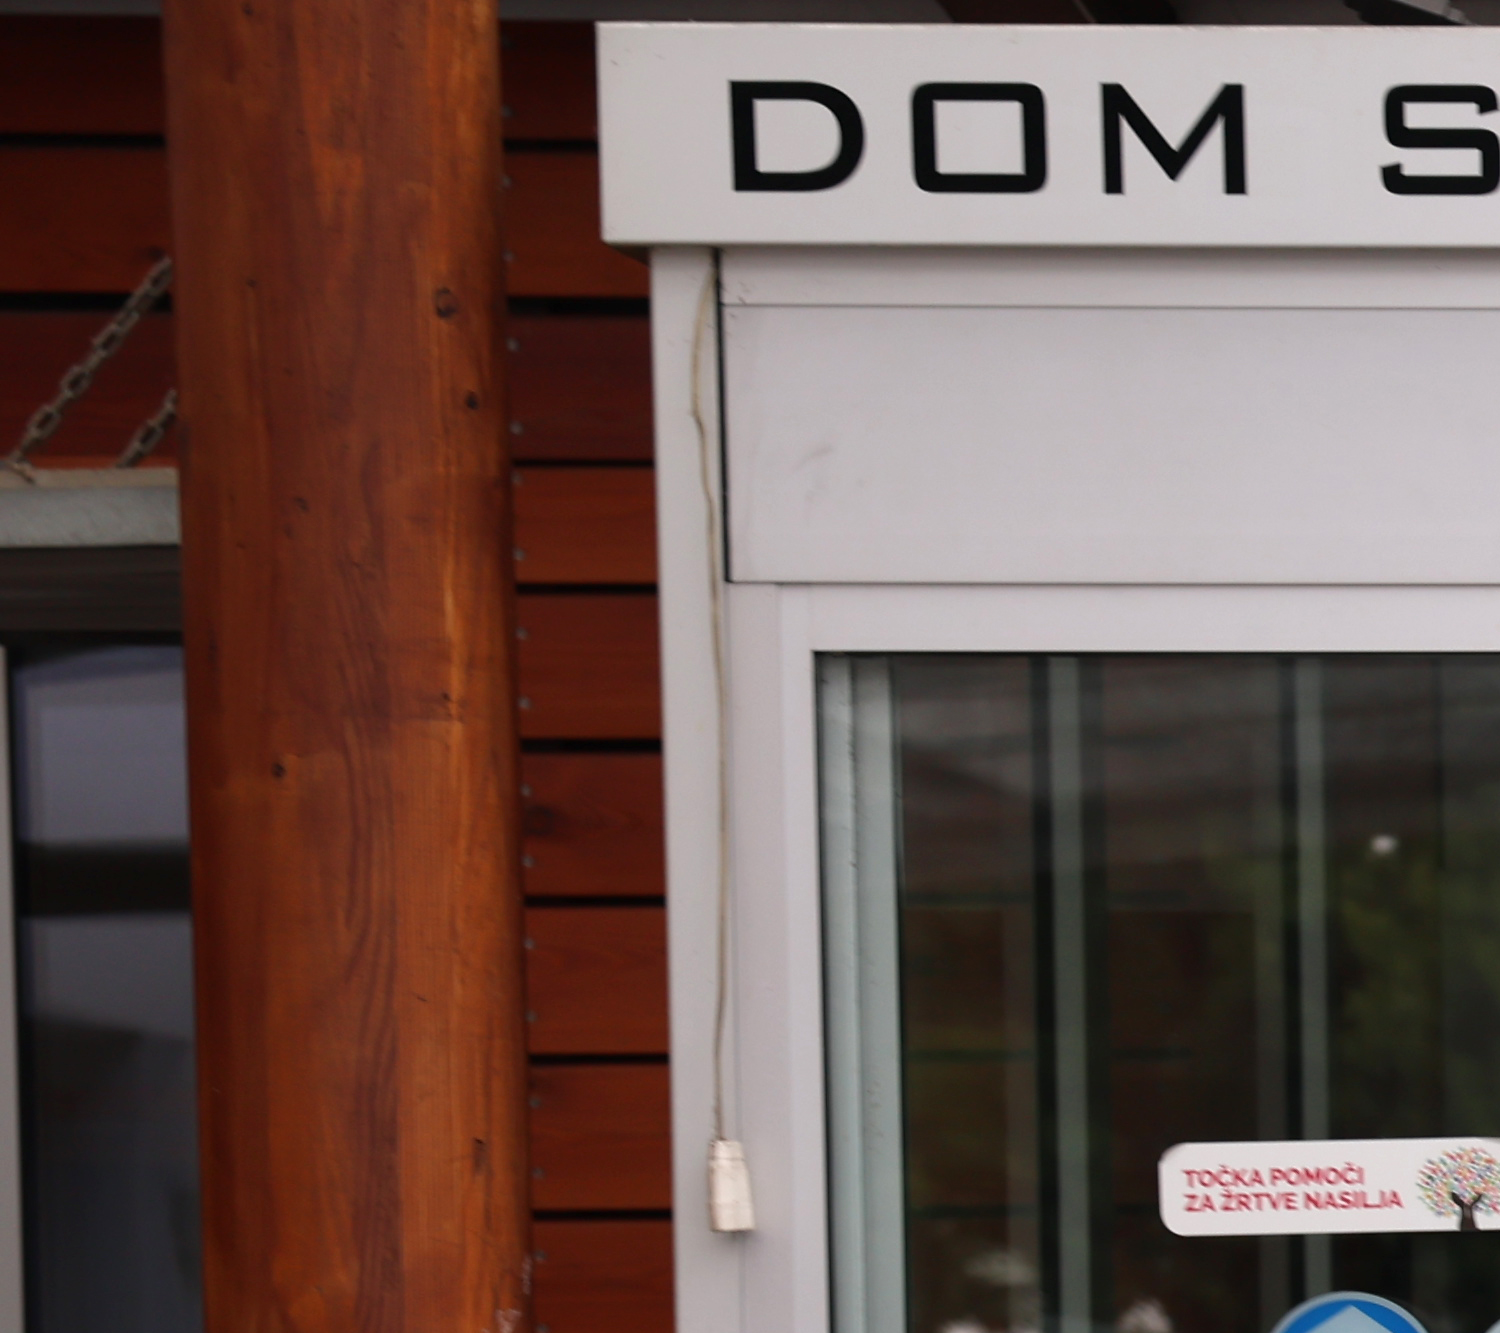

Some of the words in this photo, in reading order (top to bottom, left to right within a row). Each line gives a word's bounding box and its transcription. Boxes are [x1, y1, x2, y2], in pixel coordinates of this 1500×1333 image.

[729, 80, 1247, 195] DOM
[1182, 1164, 1266, 1187] TOČKA
[1269, 1161, 1365, 1186] POMOČI
[1183, 1192, 1217, 1213] ZA
[1220, 1188, 1299, 1212] ŽRTVE
[1303, 1189, 1405, 1210] NASILJA
